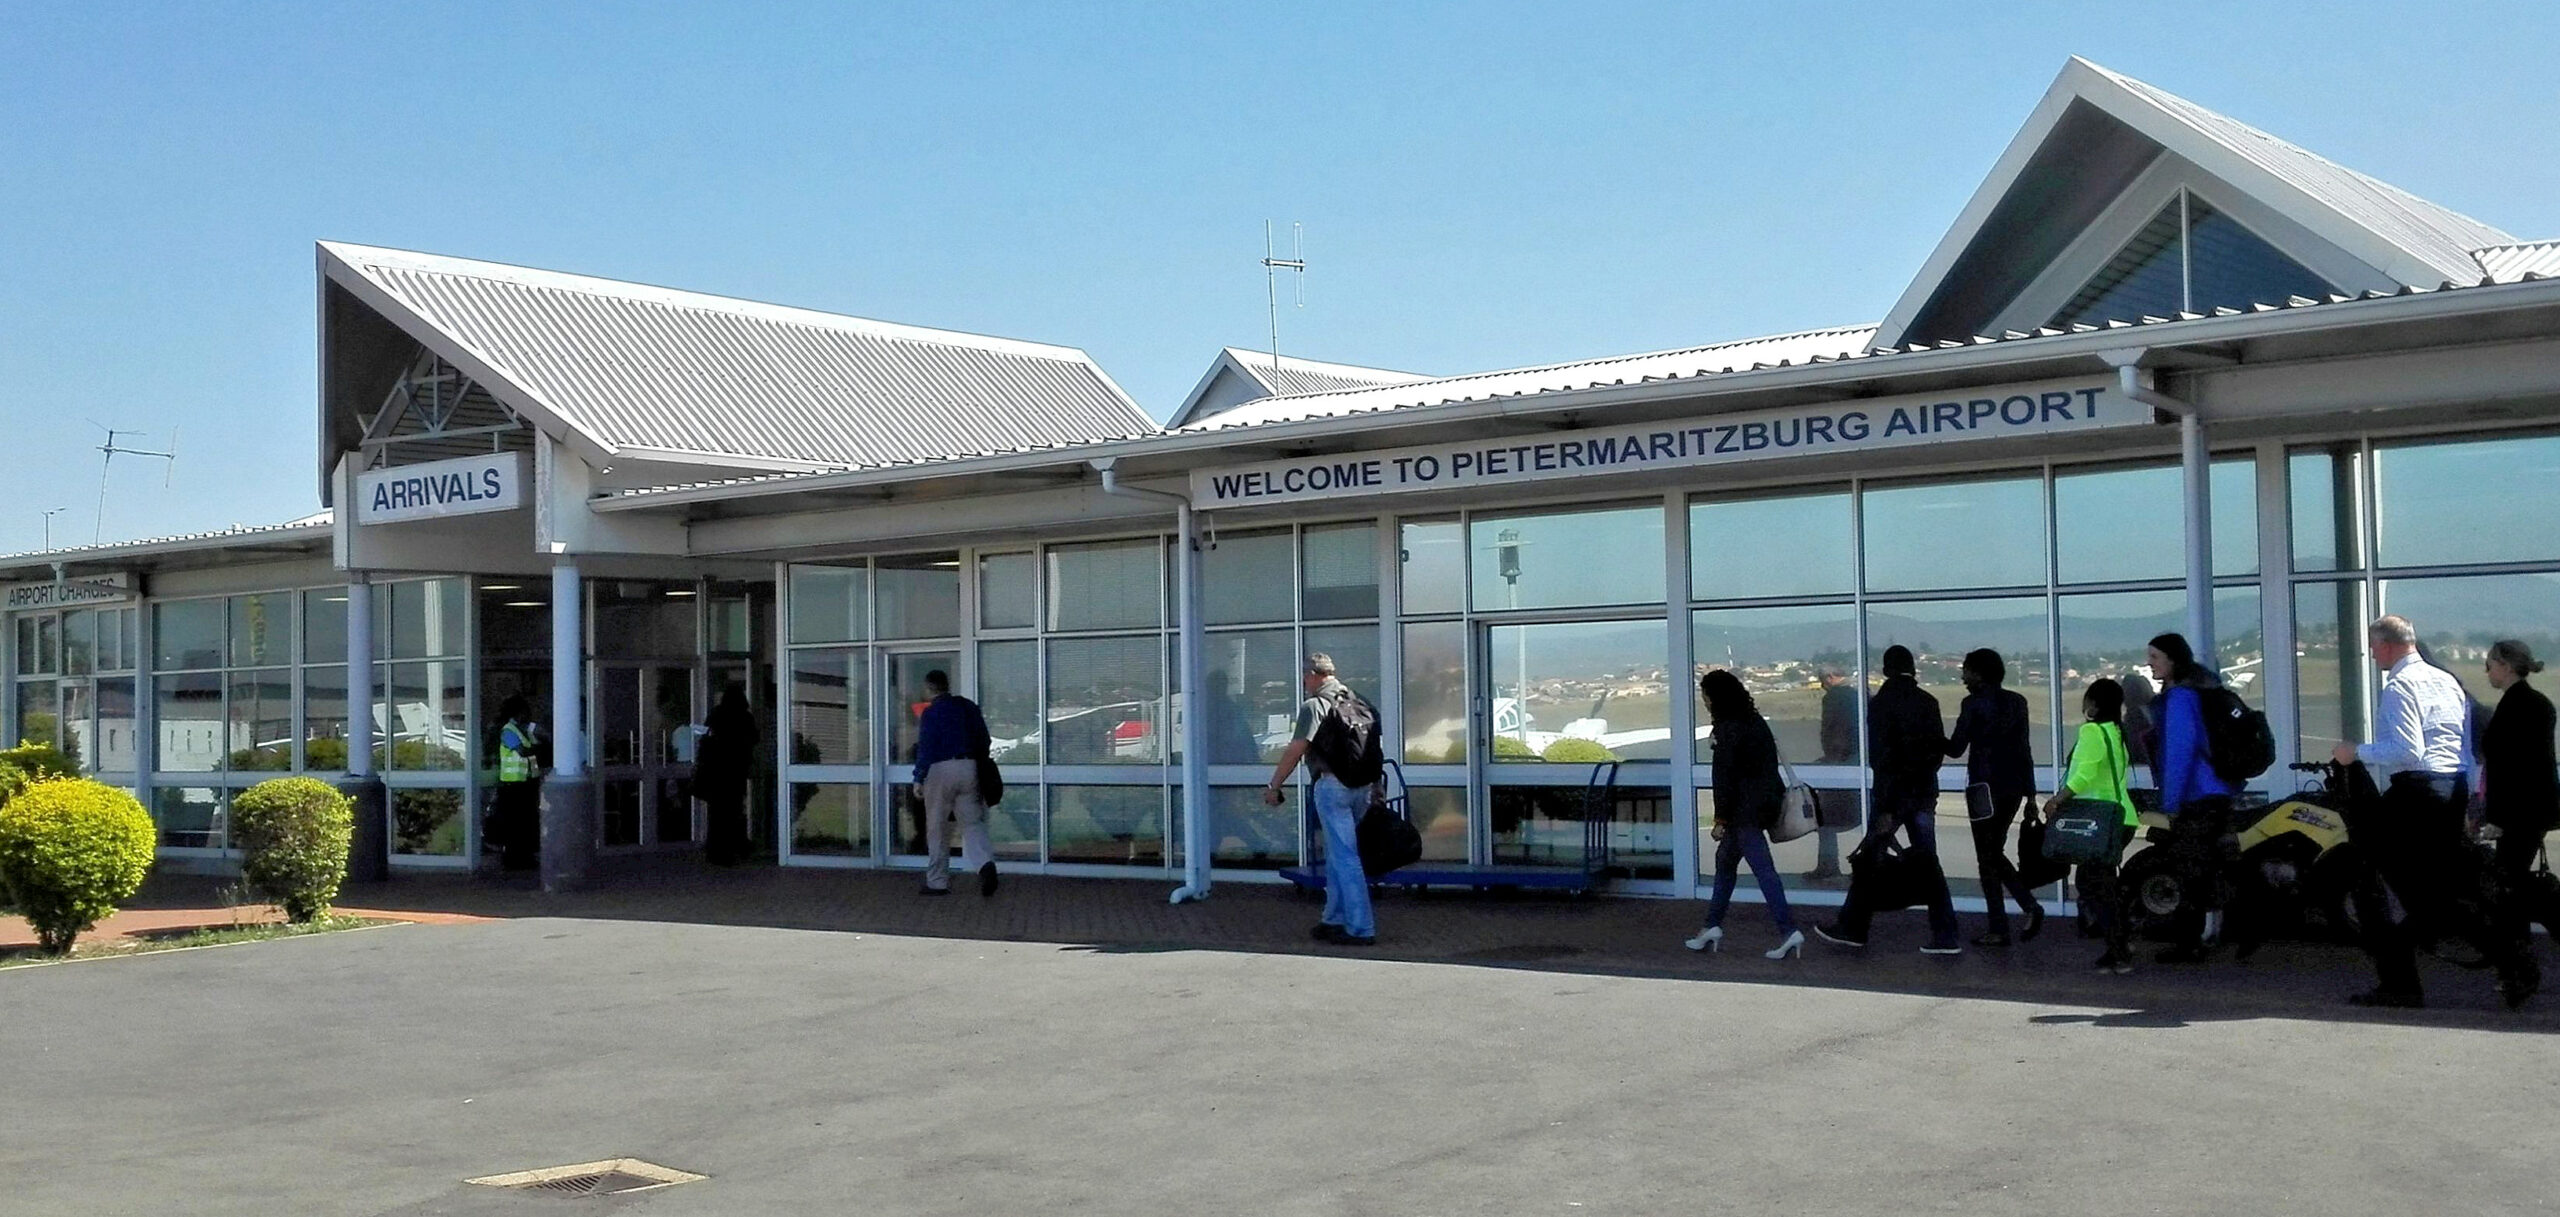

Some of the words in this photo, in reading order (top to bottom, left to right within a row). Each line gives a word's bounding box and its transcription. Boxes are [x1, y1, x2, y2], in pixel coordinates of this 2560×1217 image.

[1212, 460, 1382, 500] WELCOME
[1392, 455, 1440, 483] TO
[1451, 411, 1870, 479] PIETERMARITZBURG
[1883, 386, 2106, 438] AIRPORT
[372, 467, 501, 512] ARRIVALS
[9, 585, 55, 607] AIRPORT
